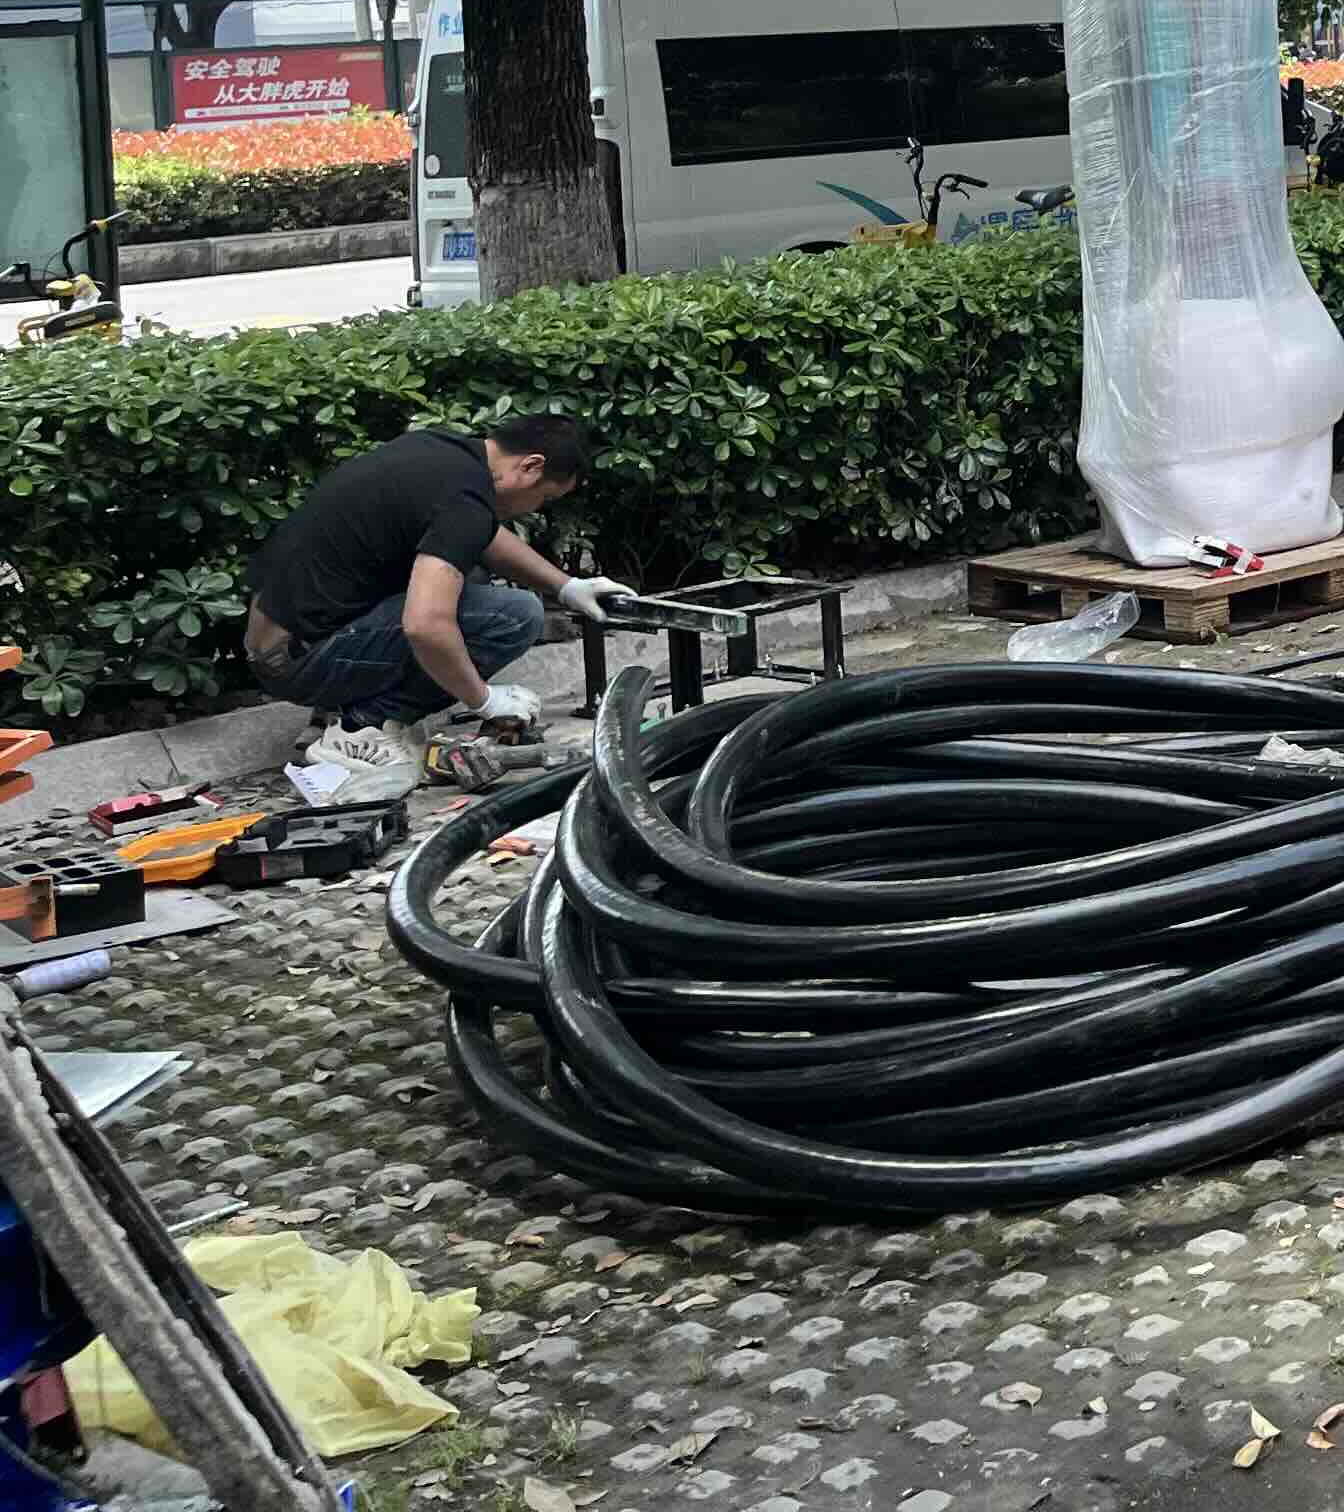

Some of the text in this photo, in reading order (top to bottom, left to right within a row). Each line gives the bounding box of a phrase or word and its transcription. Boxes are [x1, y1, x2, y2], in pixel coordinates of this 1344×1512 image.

[184, 56, 281, 80] 安全驾驶
[213, 77, 349, 104] 从大胖虎开始
